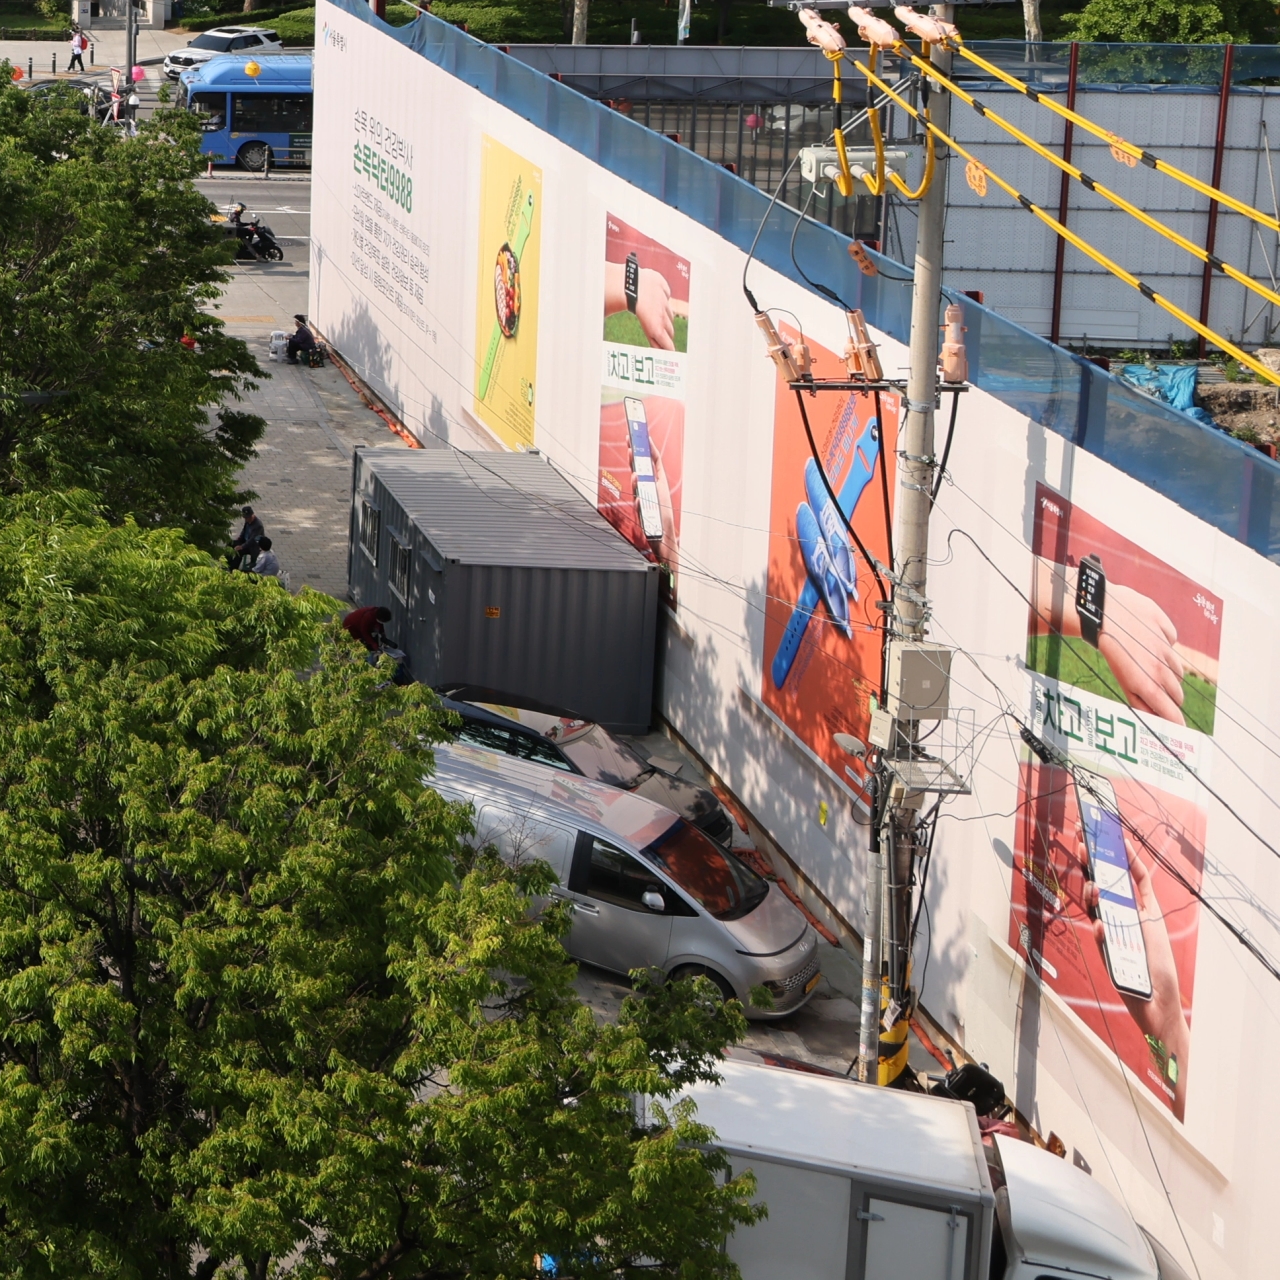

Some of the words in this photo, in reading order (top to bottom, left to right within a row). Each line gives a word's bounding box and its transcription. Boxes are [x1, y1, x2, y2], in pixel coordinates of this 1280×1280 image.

[354, 107, 367, 138] 손목
[369, 117, 382, 149] 위의
[384, 127, 413, 171] 건강박사
[353, 138, 413, 214] 손목닥터9988
[392, 237, 409, 265] 건강관리
[414, 282, 424, 305] 제공
[611, 350, 630, 380] 차고
[635, 355, 654, 385] 보고
[1043, 687, 1083, 743] 차고
[1095, 708, 1138, 765] 보고
